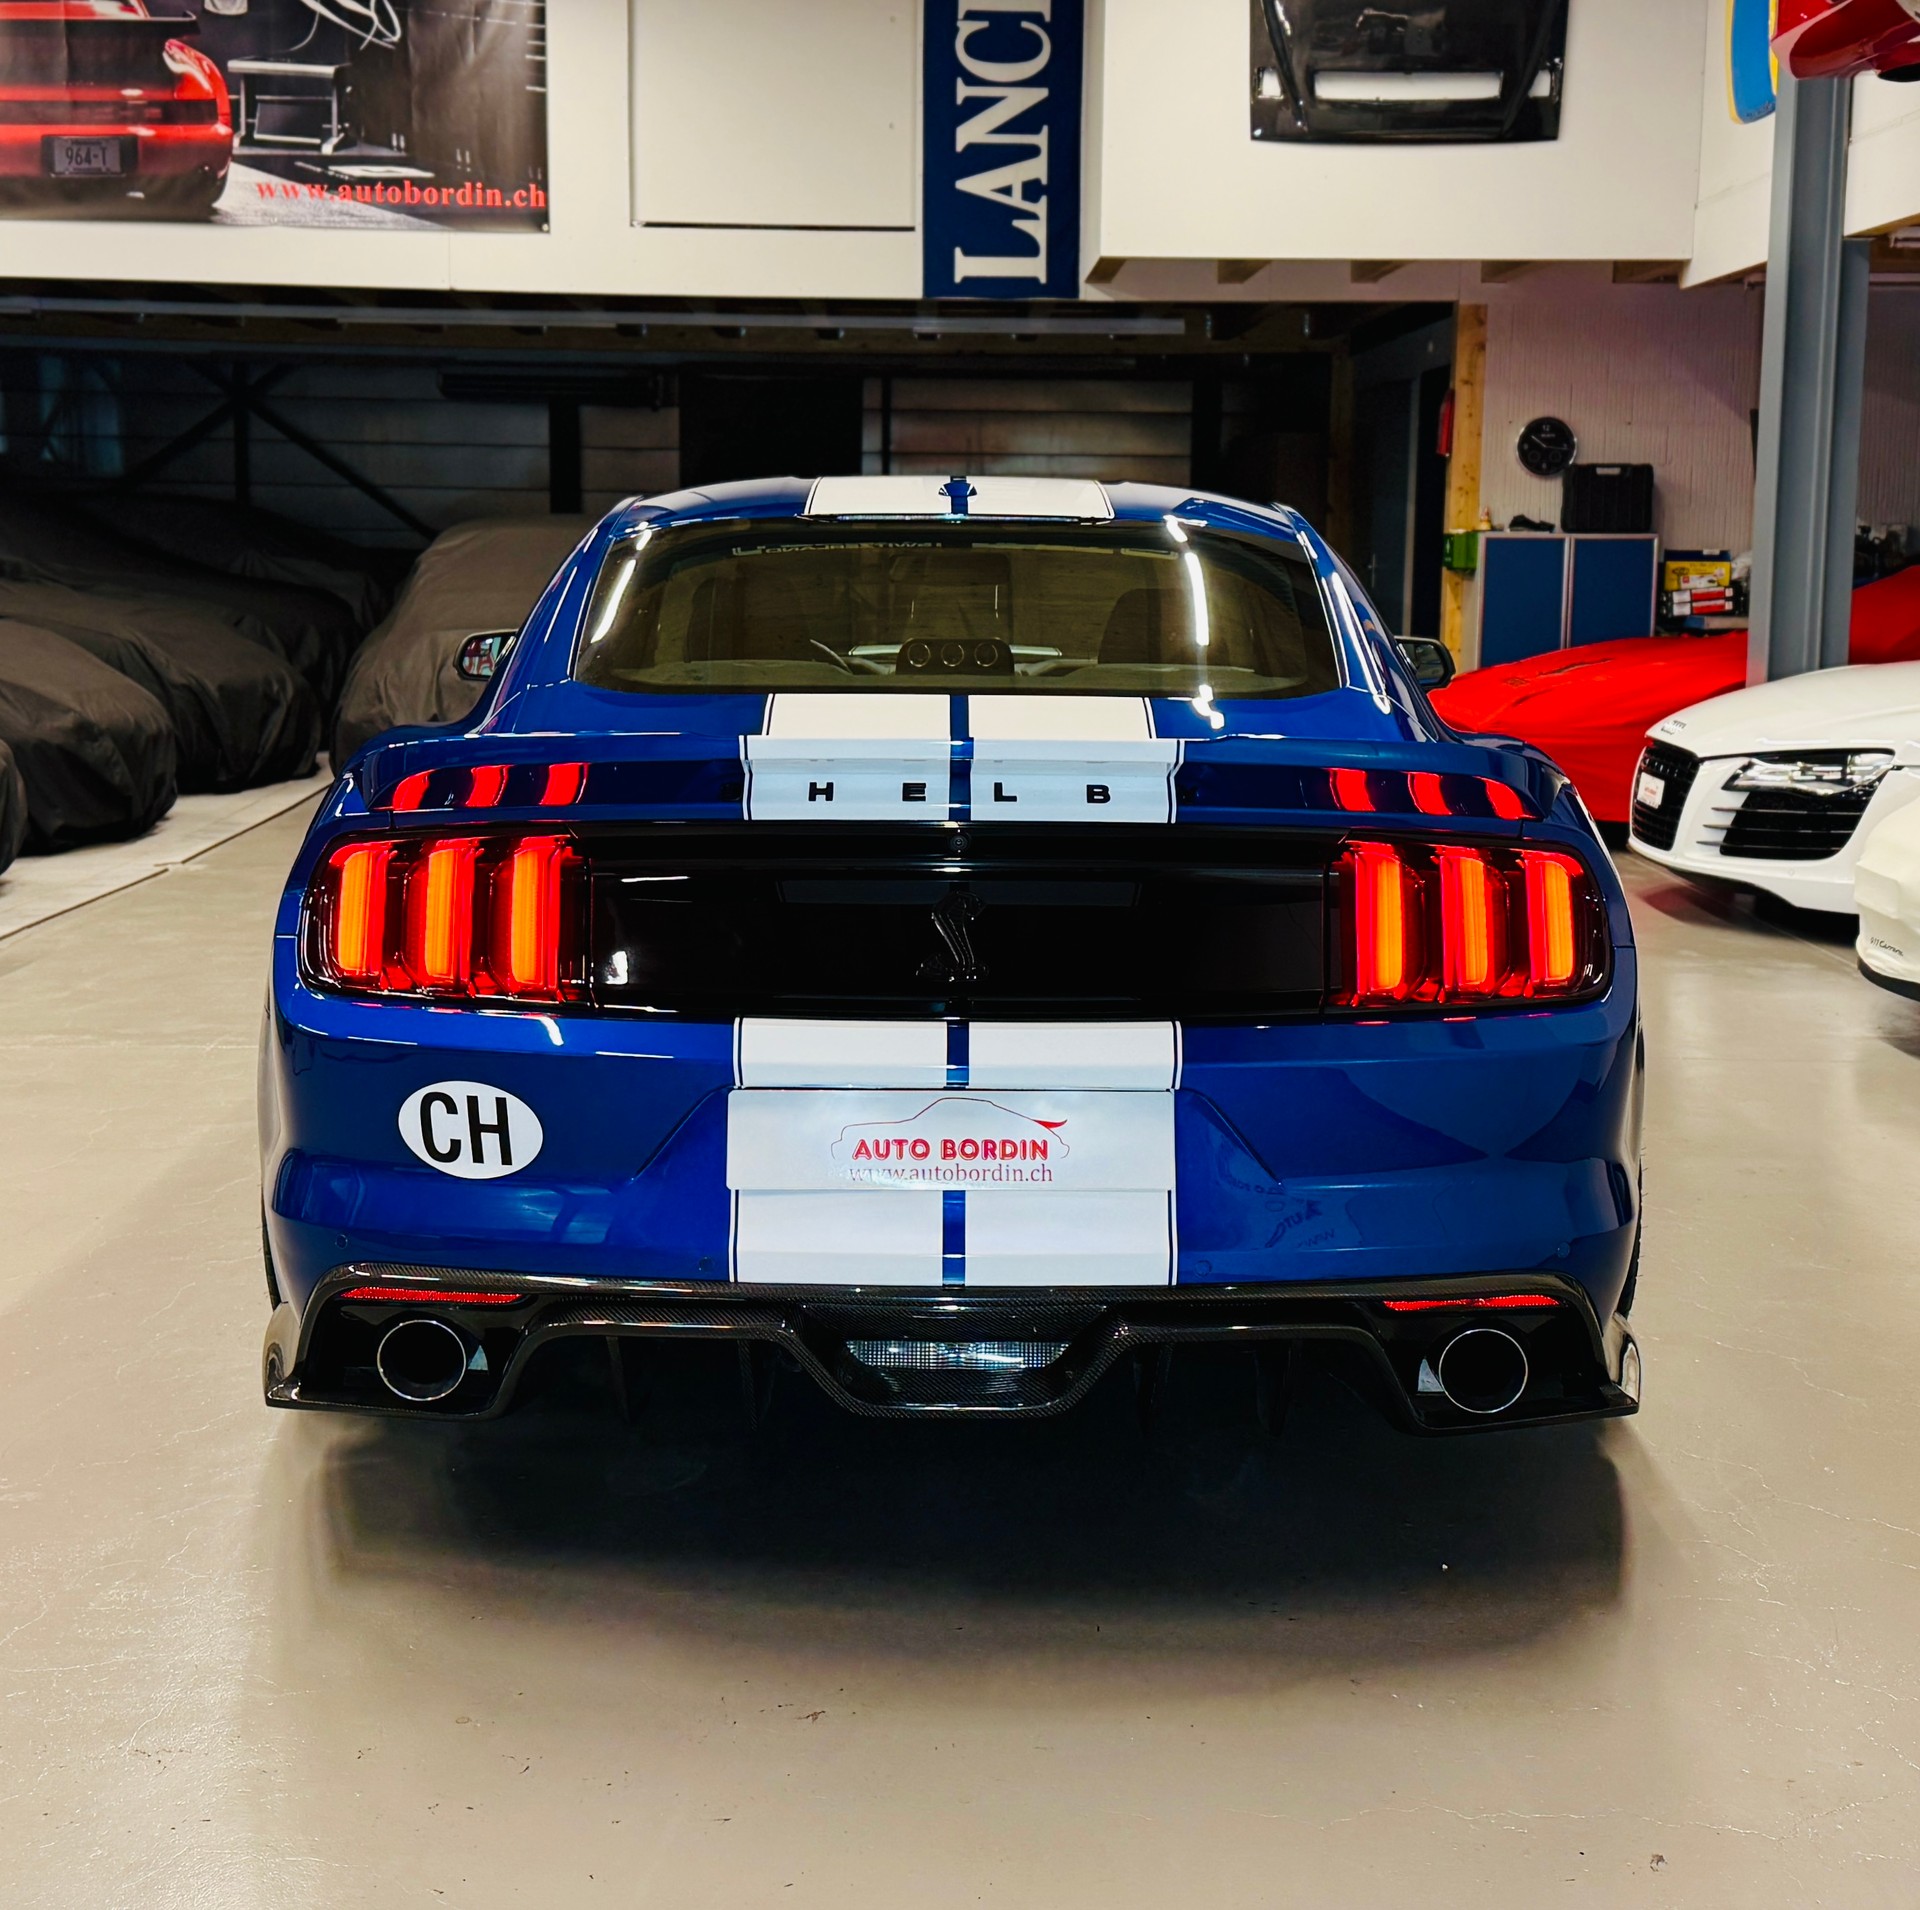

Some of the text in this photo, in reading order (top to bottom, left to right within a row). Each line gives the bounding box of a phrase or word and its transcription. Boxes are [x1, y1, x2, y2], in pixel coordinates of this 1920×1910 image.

[65, 146, 107, 167] 964-T
[255, 180, 546, 208] www.autobordin.ch
[419, 1091, 513, 1166] CH
[851, 1138, 1048, 1161] AUTO BORDIN
[849, 1163, 1053, 1182] www.autobordin.ch
